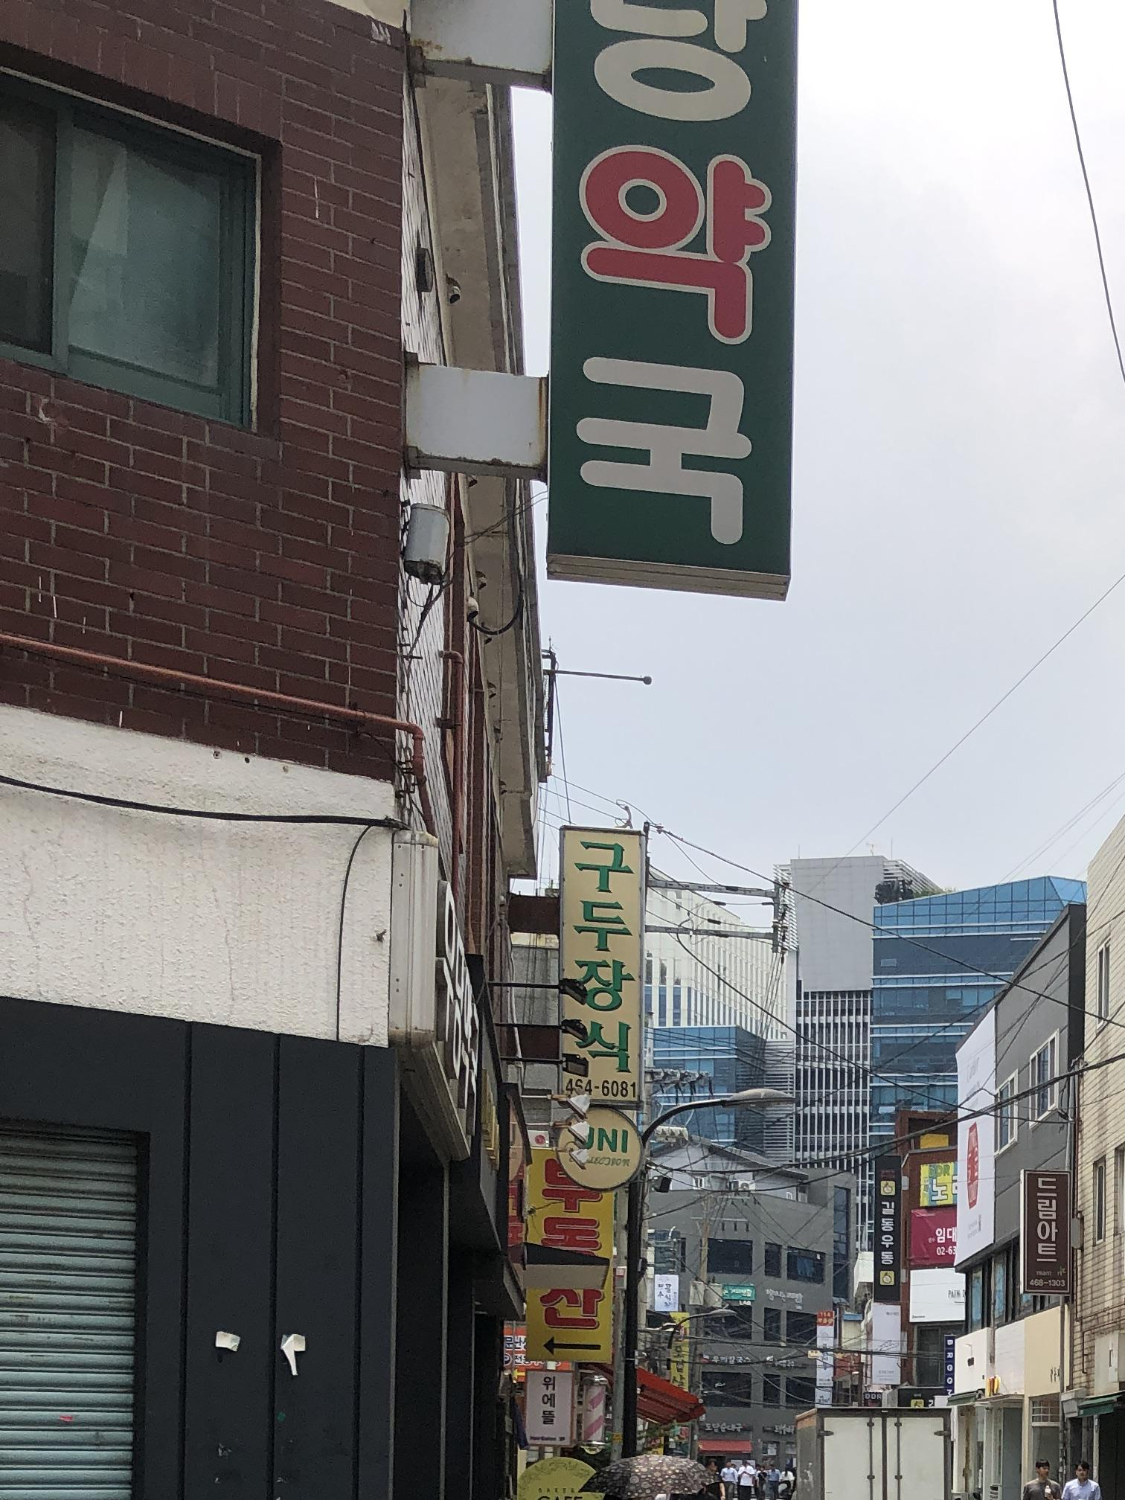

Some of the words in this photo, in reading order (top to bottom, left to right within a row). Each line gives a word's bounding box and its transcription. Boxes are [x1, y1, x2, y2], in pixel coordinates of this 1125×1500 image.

[573, 840, 635, 1074] 구두장식
[935, 1227, 957, 1244] 임대
[1036, 1177, 1059, 1262] 드림아트
[1029, 1279, 1065, 1287] 468-1303
[541, 1376, 556, 1426] 위에뜰
